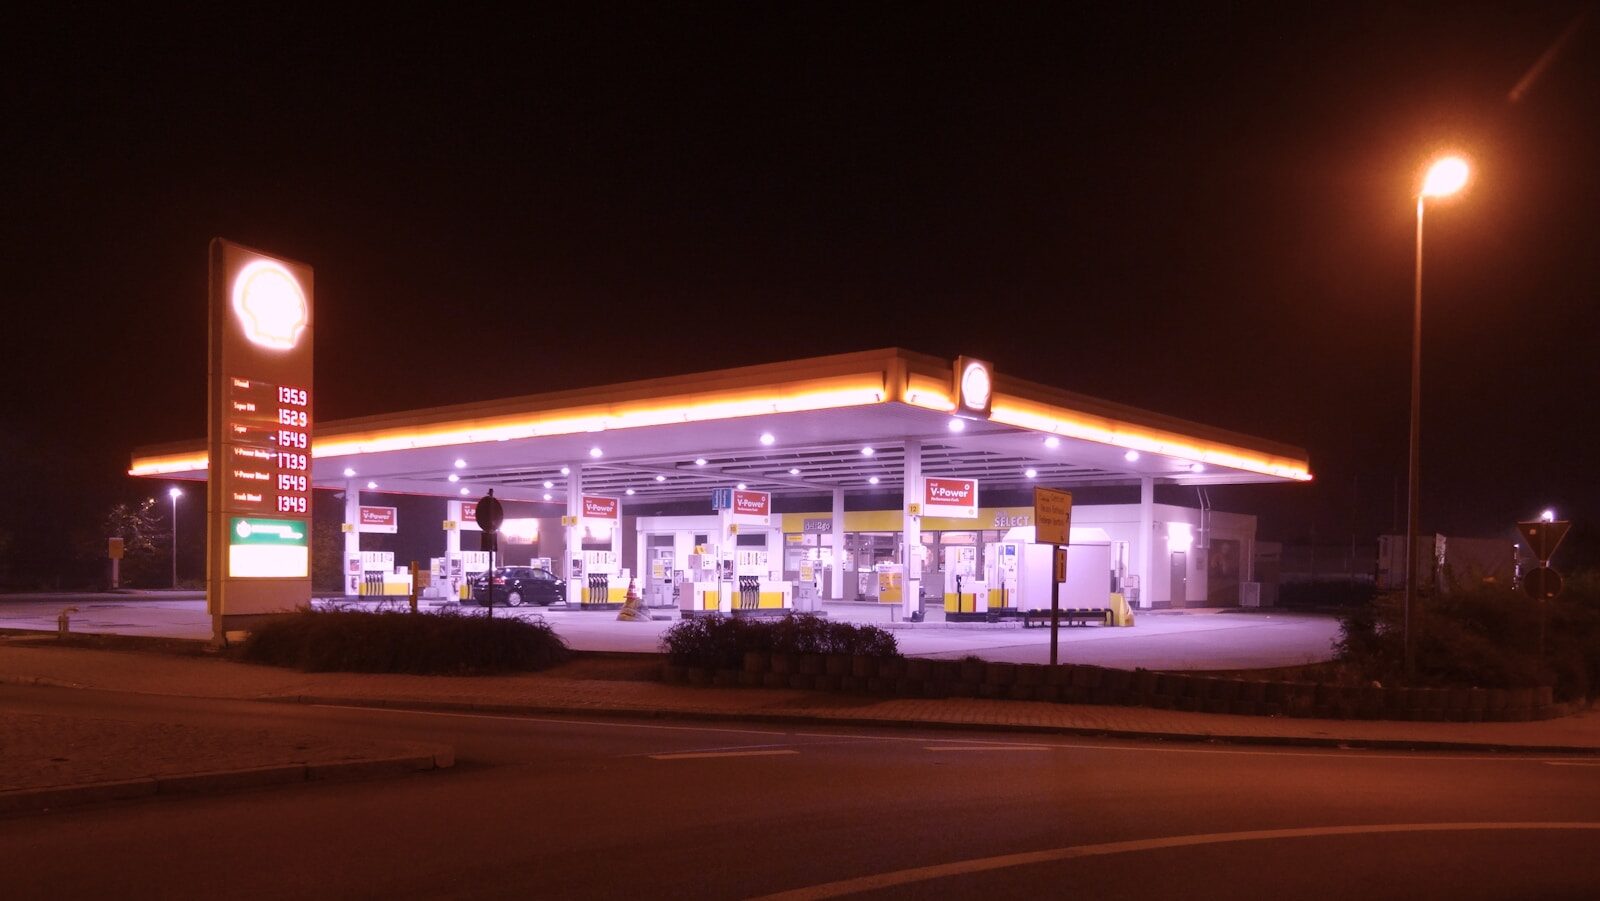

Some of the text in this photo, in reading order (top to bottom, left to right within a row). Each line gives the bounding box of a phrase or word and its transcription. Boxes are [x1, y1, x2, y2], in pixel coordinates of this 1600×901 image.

[930, 487, 969, 498] V-Power
[585, 503, 614, 513] V-Power
[736, 498, 765, 508] V-Power
[363, 512, 391, 520] V-Power
[994, 516, 1029, 527] SELECT
